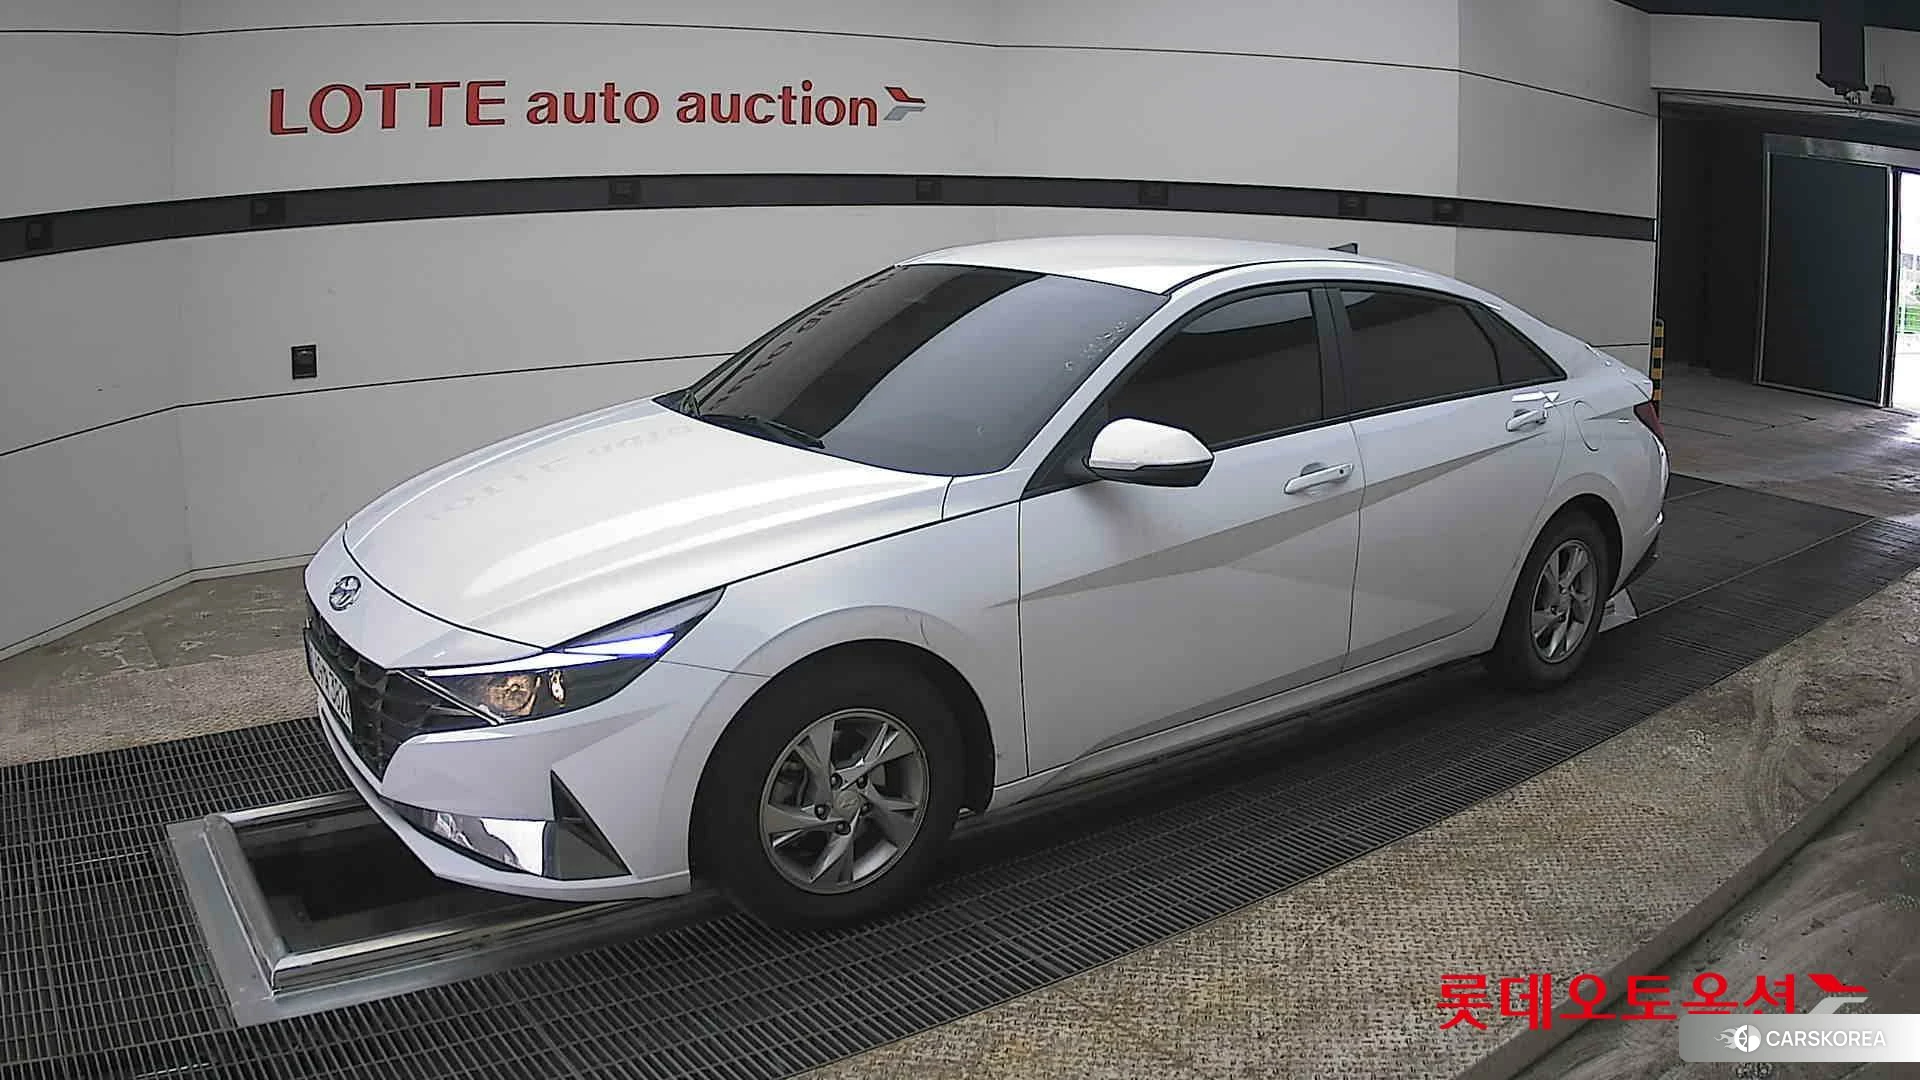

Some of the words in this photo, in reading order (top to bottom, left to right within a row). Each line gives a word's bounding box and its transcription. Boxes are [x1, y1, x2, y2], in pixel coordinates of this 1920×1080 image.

[269, 81, 506, 134] LOTTE
[526, 82, 658, 125] auto
[676, 80, 878, 127] auction
